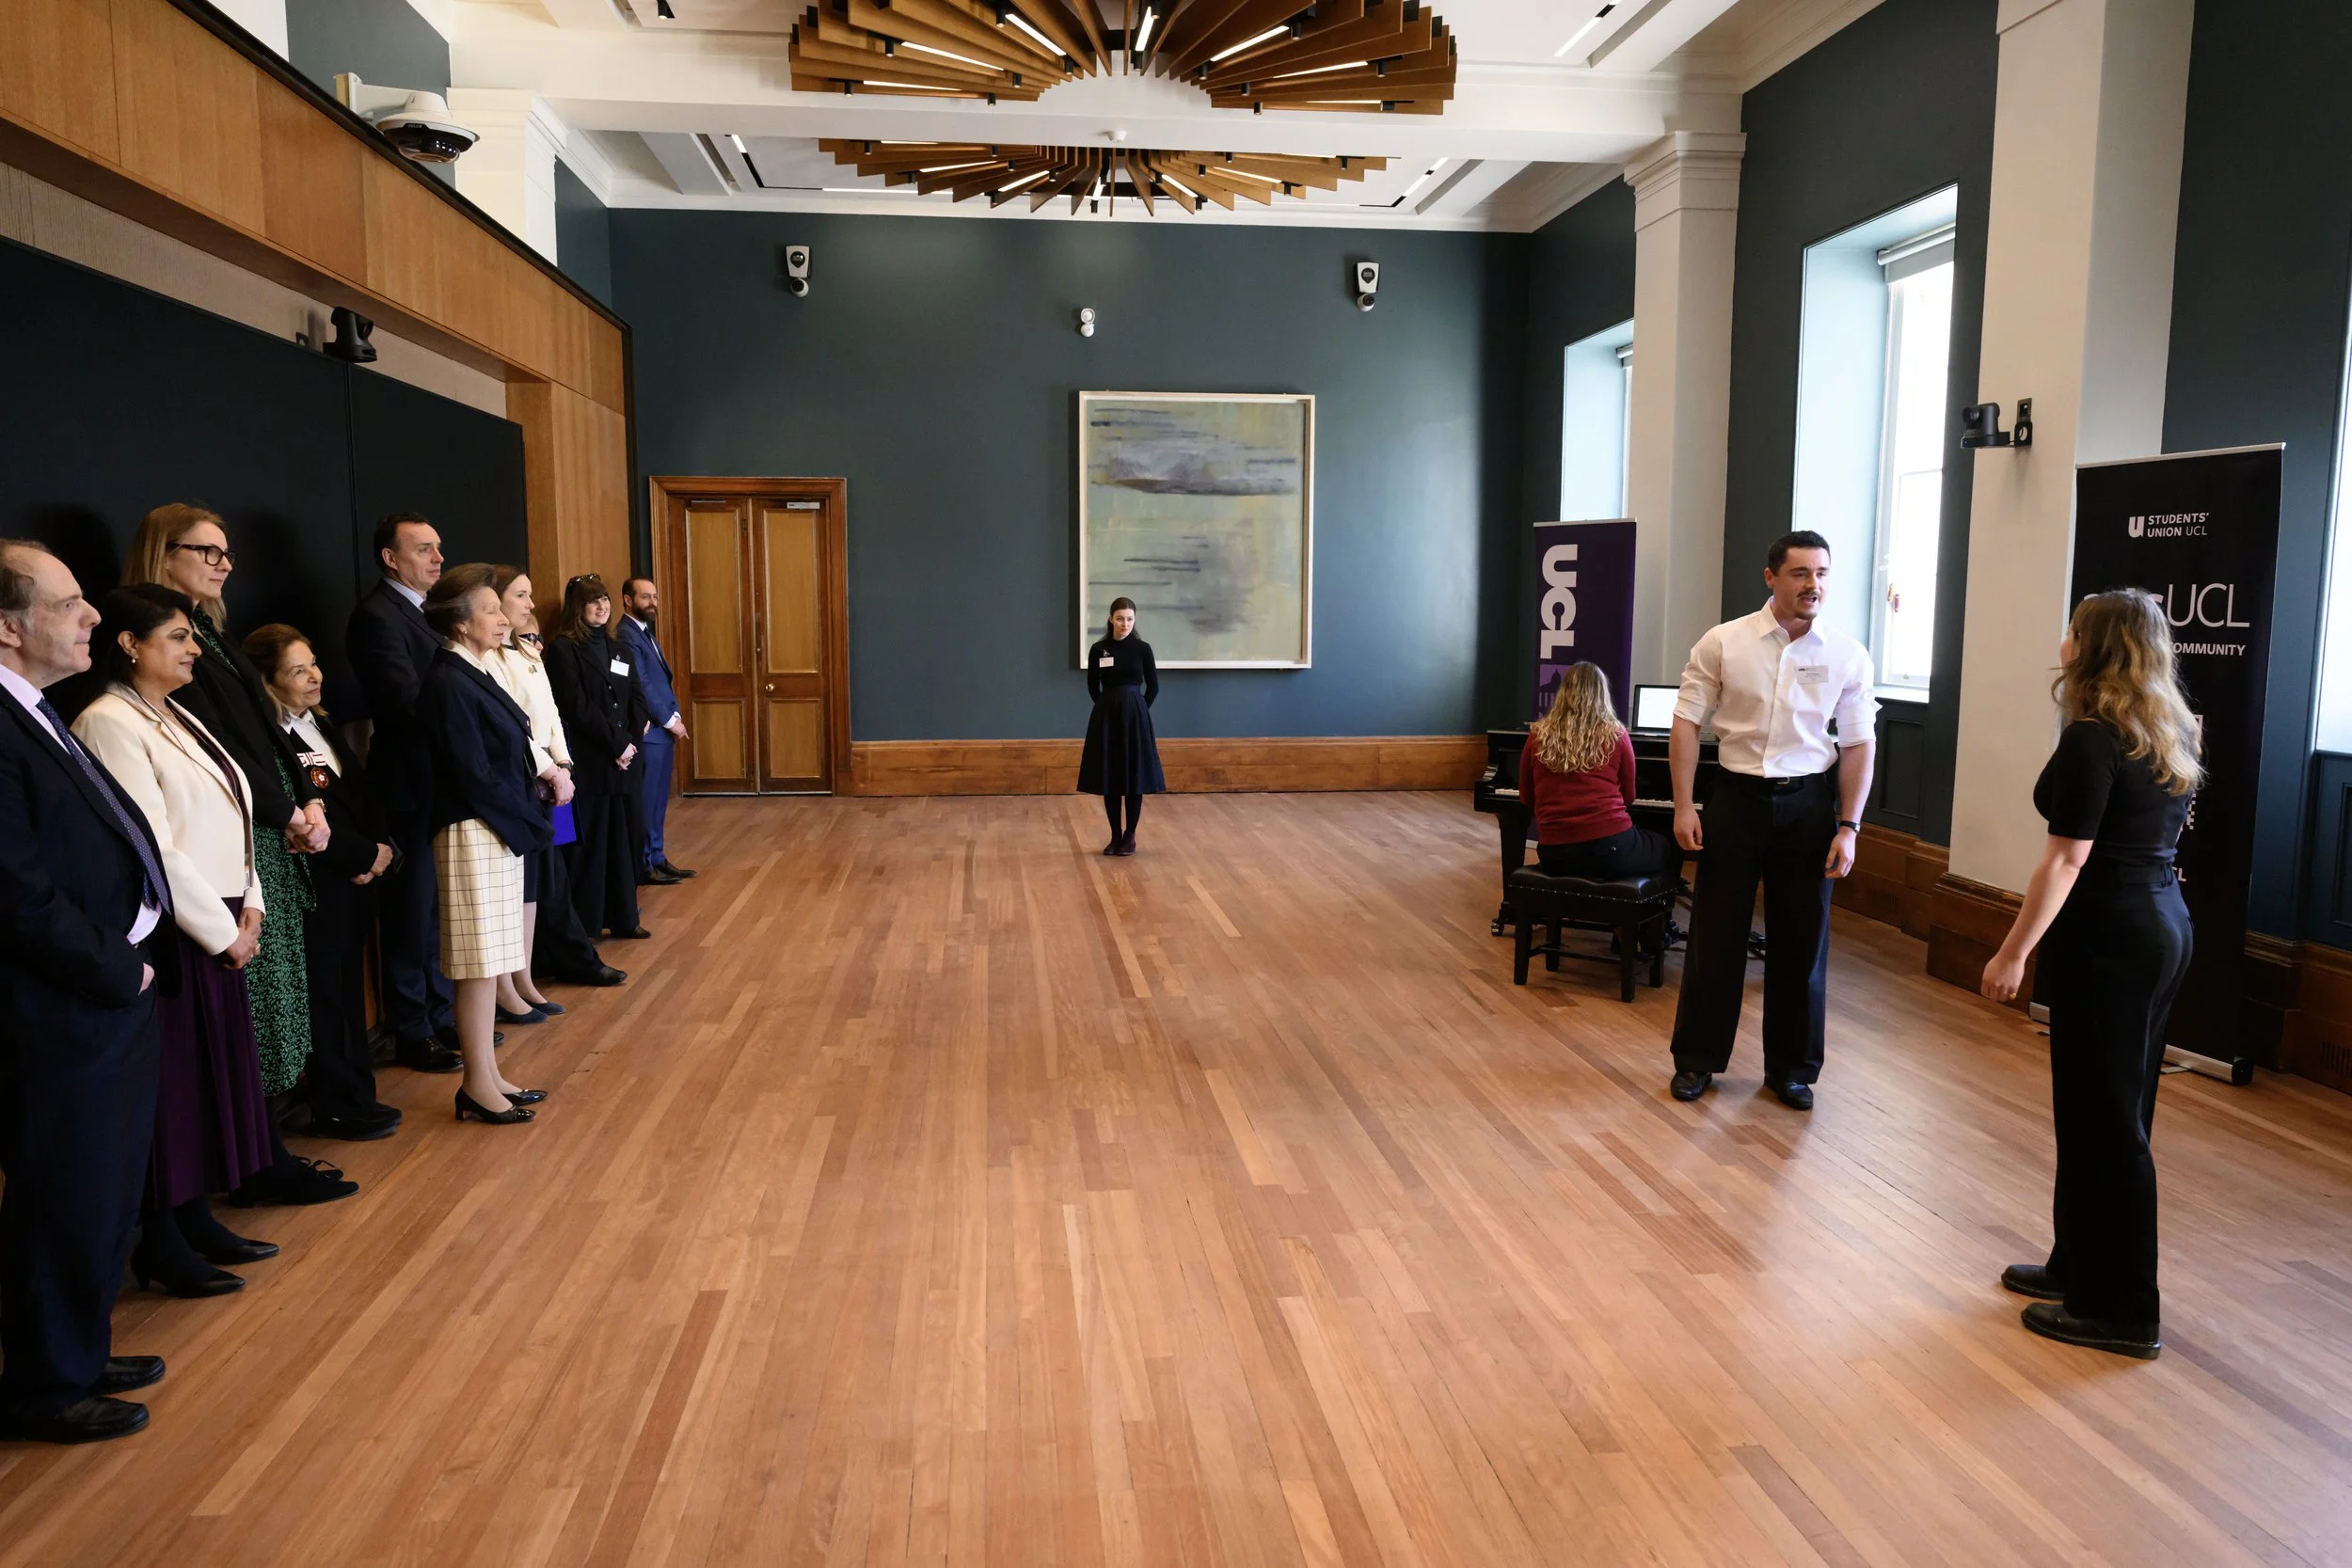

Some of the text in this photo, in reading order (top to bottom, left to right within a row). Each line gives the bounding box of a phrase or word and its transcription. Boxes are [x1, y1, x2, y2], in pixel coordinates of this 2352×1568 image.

[2147, 526, 2208, 538] UNION UCL
[1540, 544, 1578, 659] UCL
[2172, 641, 2247, 657] OMMUNITY
